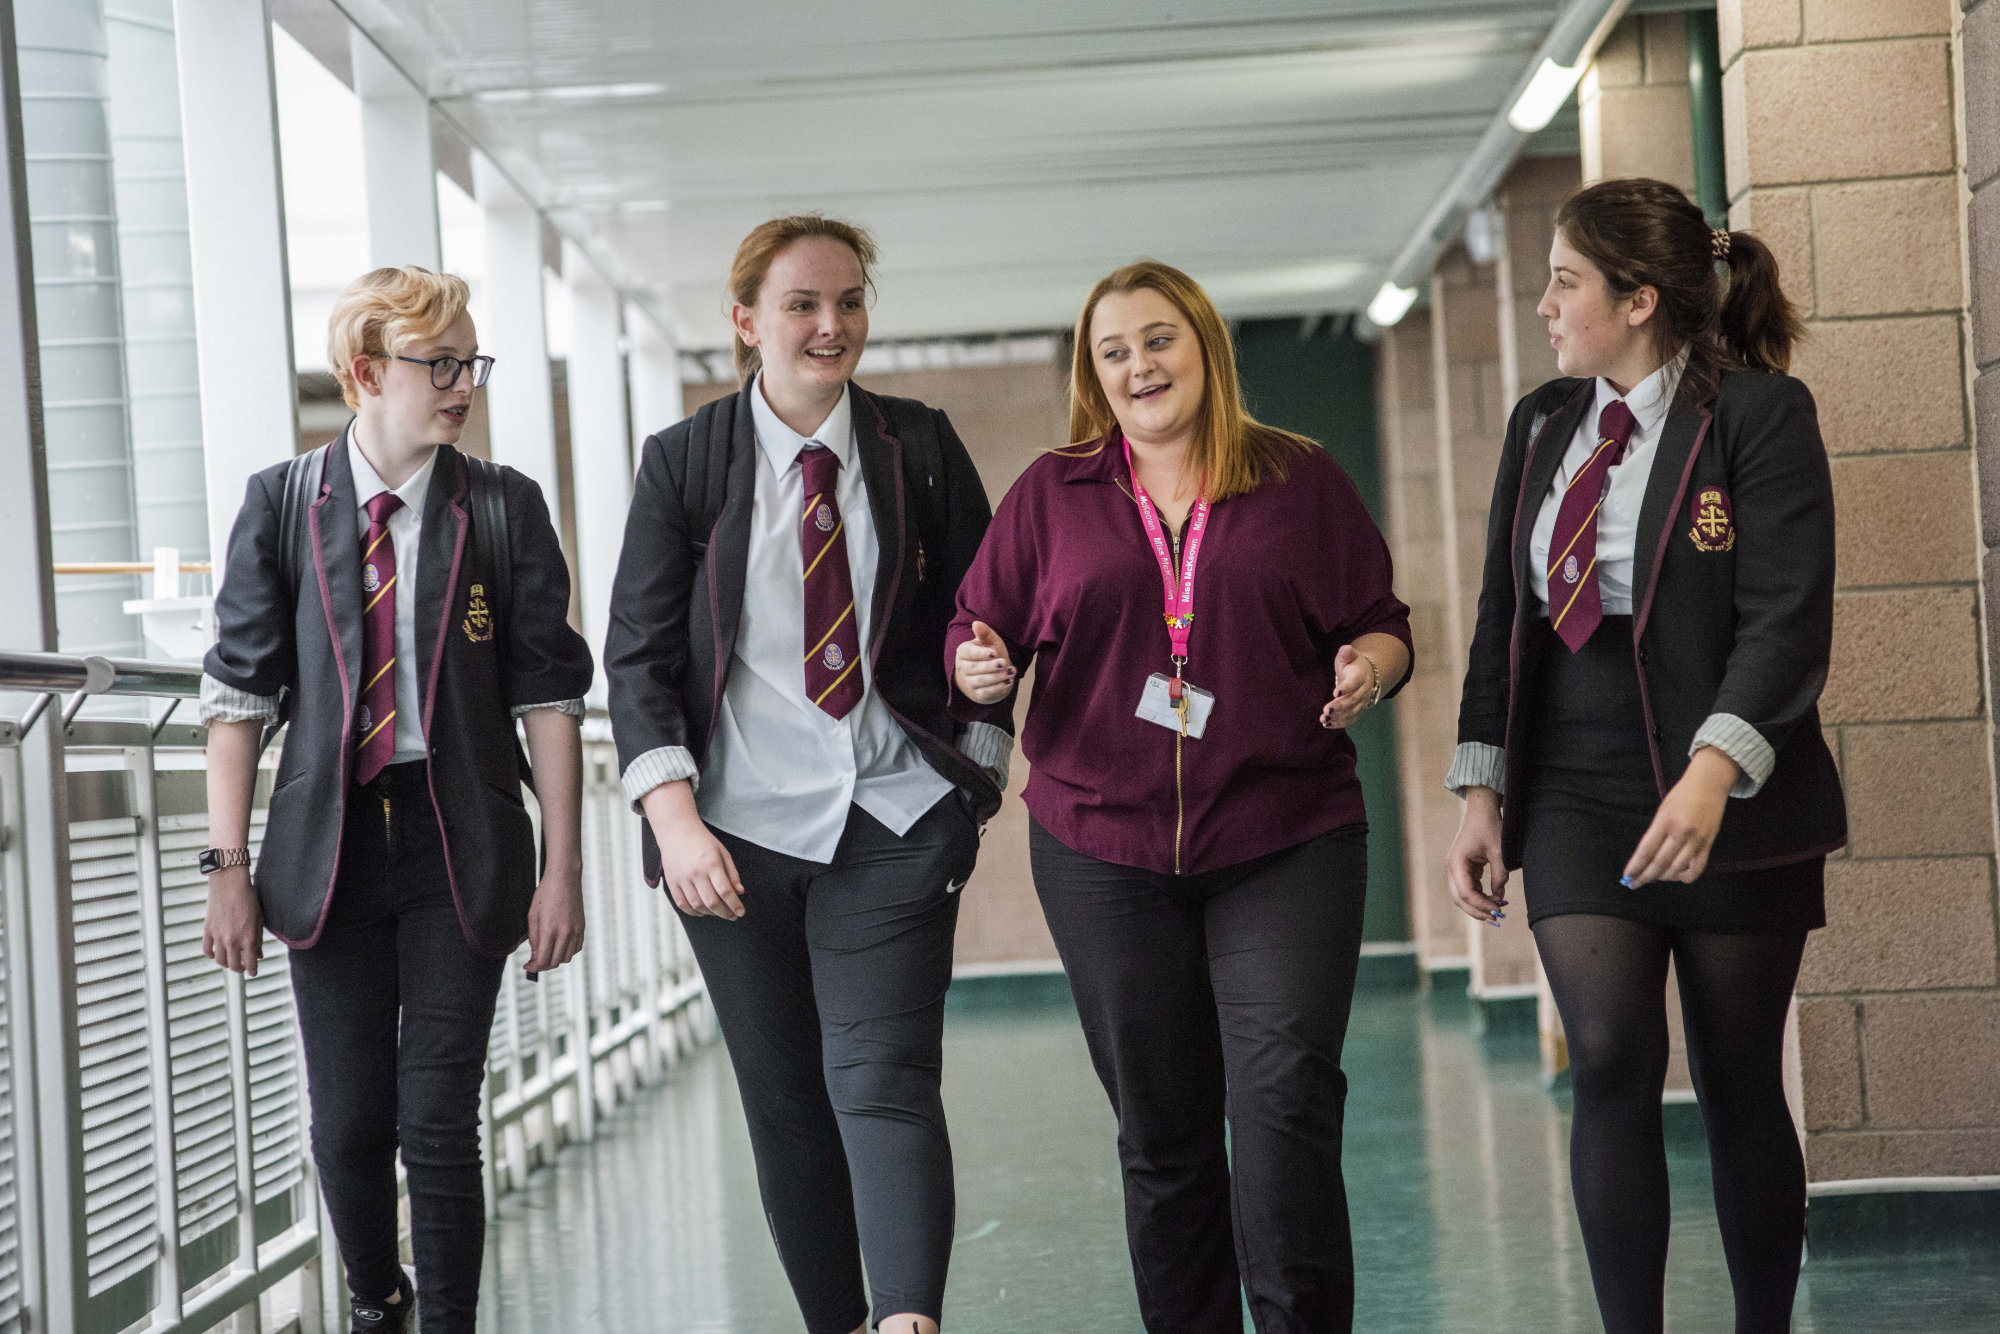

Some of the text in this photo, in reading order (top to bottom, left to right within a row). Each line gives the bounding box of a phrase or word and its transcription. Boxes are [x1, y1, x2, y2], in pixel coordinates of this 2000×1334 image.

[1140, 495, 1155, 531] McKeown
[1193, 511, 1204, 531] Miss
[1153, 537, 1174, 600] Miss McKeown
[1182, 538, 1198, 602] Miss McKeown
